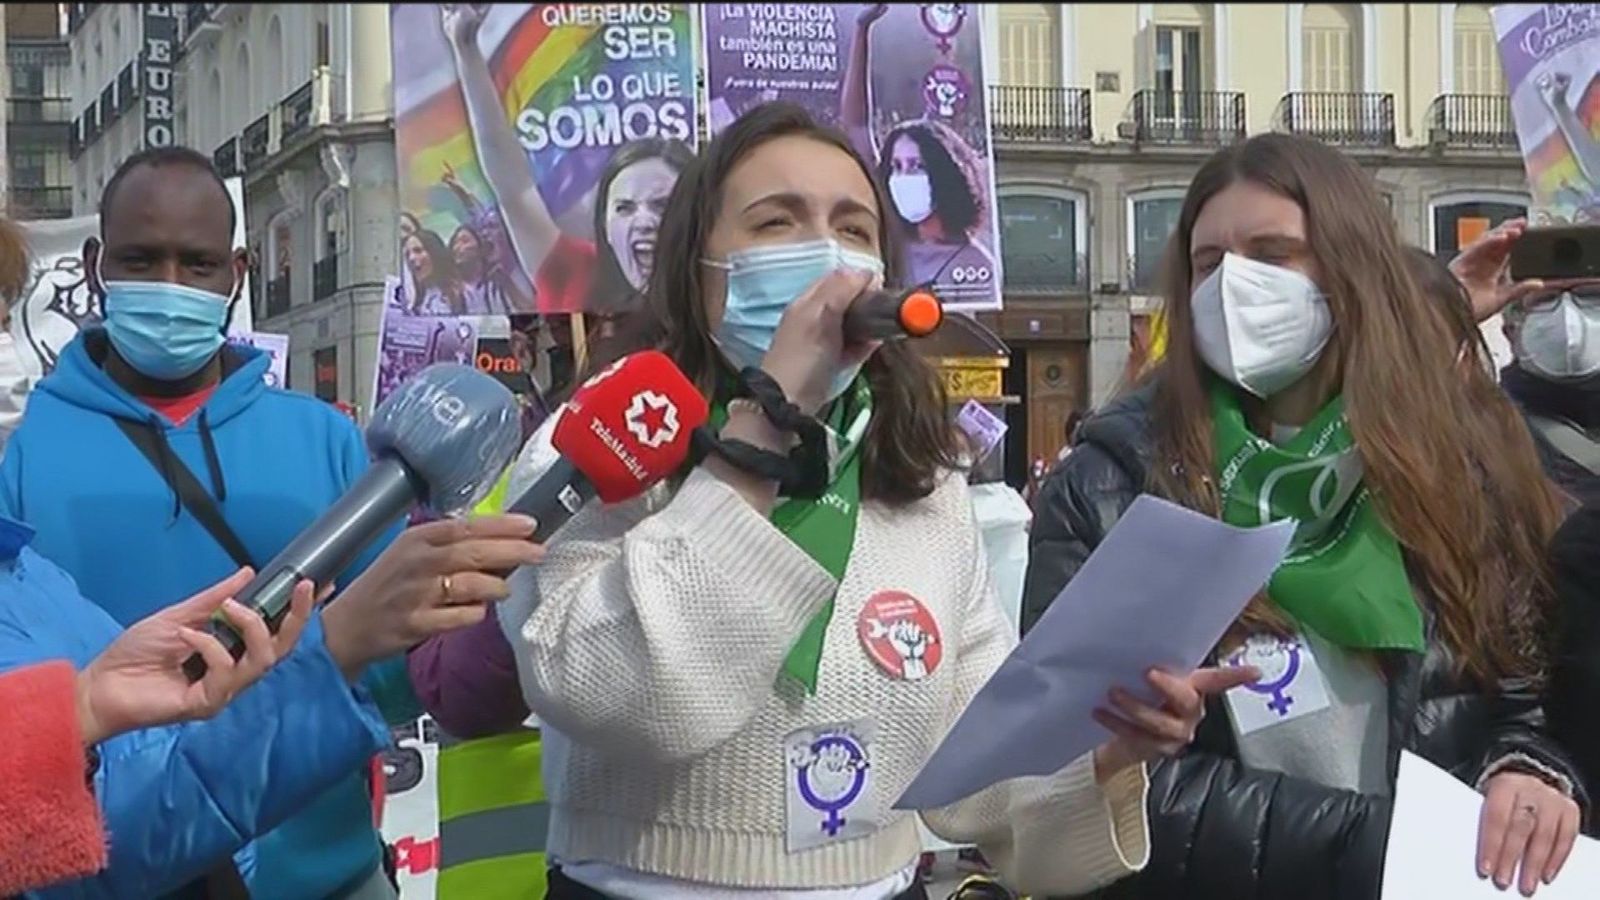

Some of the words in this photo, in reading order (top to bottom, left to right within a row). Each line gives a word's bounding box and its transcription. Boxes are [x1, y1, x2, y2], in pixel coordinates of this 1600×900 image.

[542, 4, 673, 26] QUEREMOS
[749, 20, 836, 39] MACHISTA
[604, 27, 676, 59] SER
[720, 35, 784, 52] también
[786, 40, 805, 53] es
[807, 41, 836, 54] una
[743, 52, 837, 71] PANDEMIA!
[573, 75, 612, 101] LO
[622, 73, 682, 99] QUE
[516, 102, 690, 150] SOMOS
